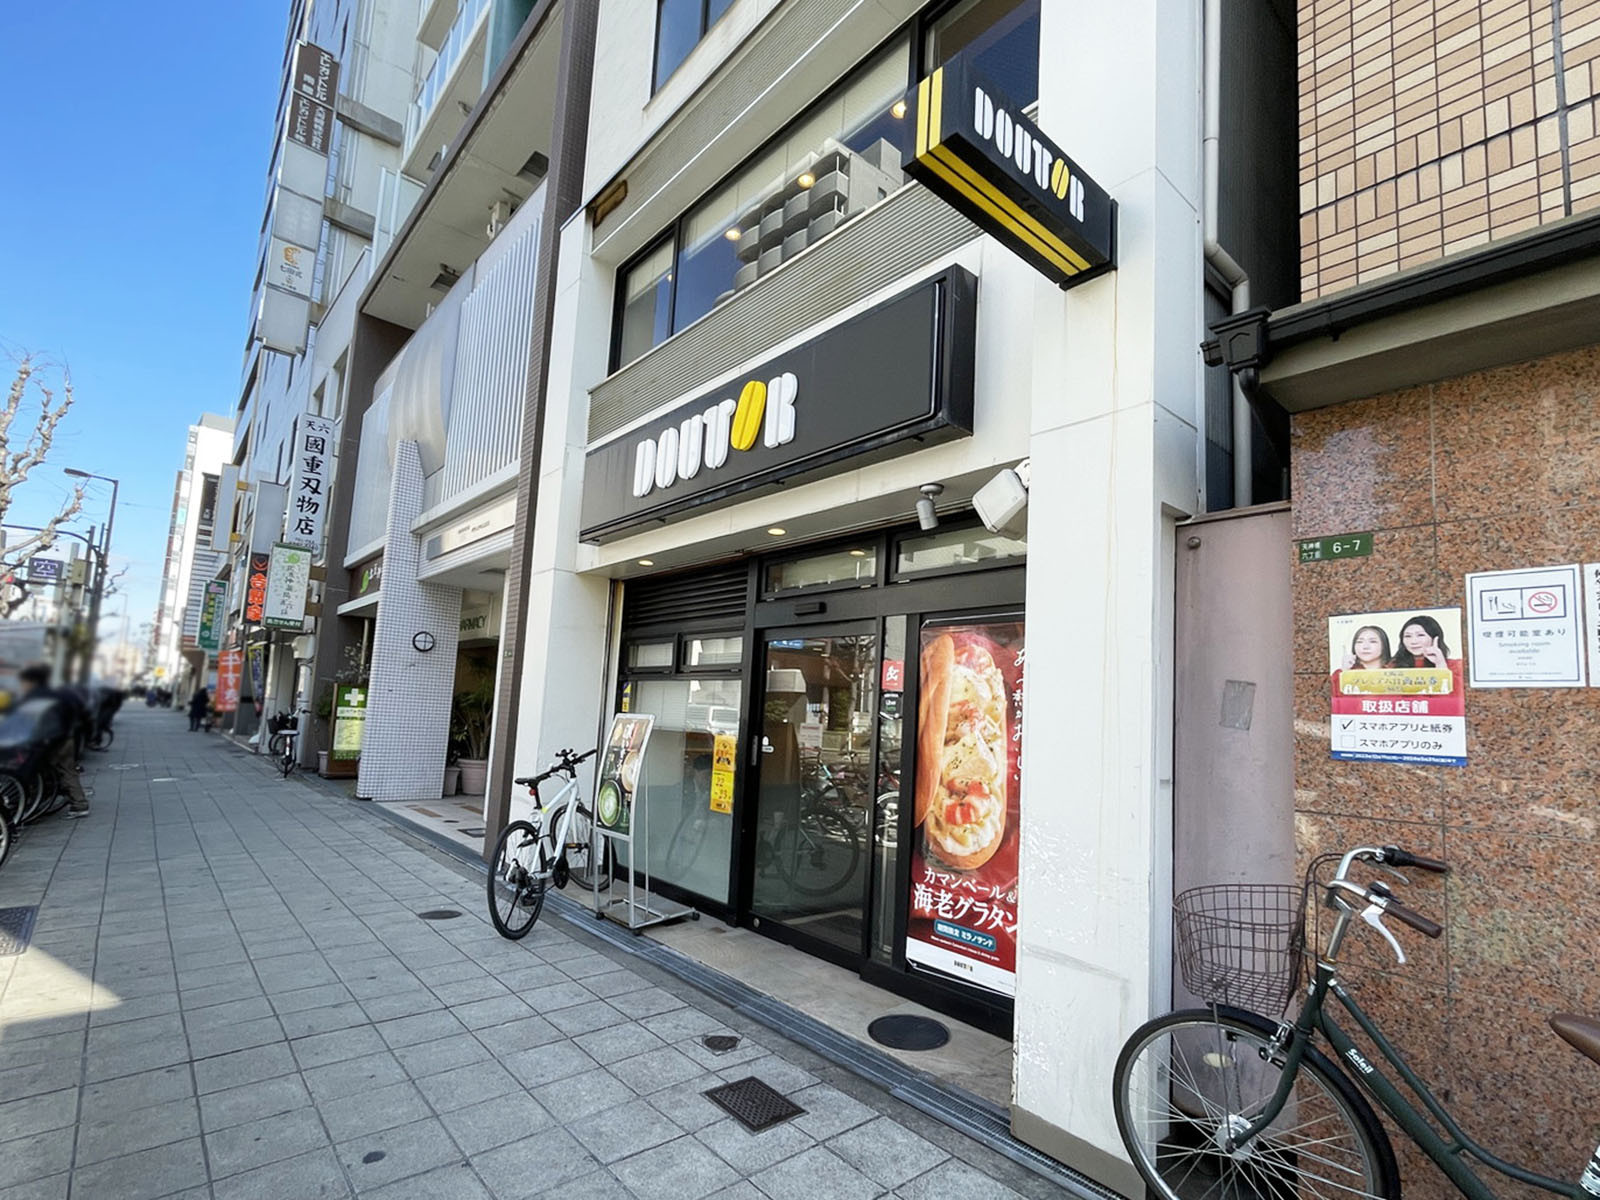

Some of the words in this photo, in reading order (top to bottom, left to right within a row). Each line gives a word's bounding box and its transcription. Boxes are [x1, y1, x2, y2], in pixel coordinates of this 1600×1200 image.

[974, 87, 1085, 223] DOUTOR
[305, 420, 331, 434] 天六
[633, 372, 799, 497] DOUTOR
[294, 434, 326, 537] 國重刃物店
[1332, 539, 1361, 554] 6-7
[1361, 700, 1430, 714] 取扱店舗
[1359, 722, 1453, 734] スマホアプリと紙券
[1359, 738, 1443, 750] スマホアプリのみ
[914, 883, 1018, 933] 海老グラタン
[1347, 1048, 1374, 1074] Soleil
